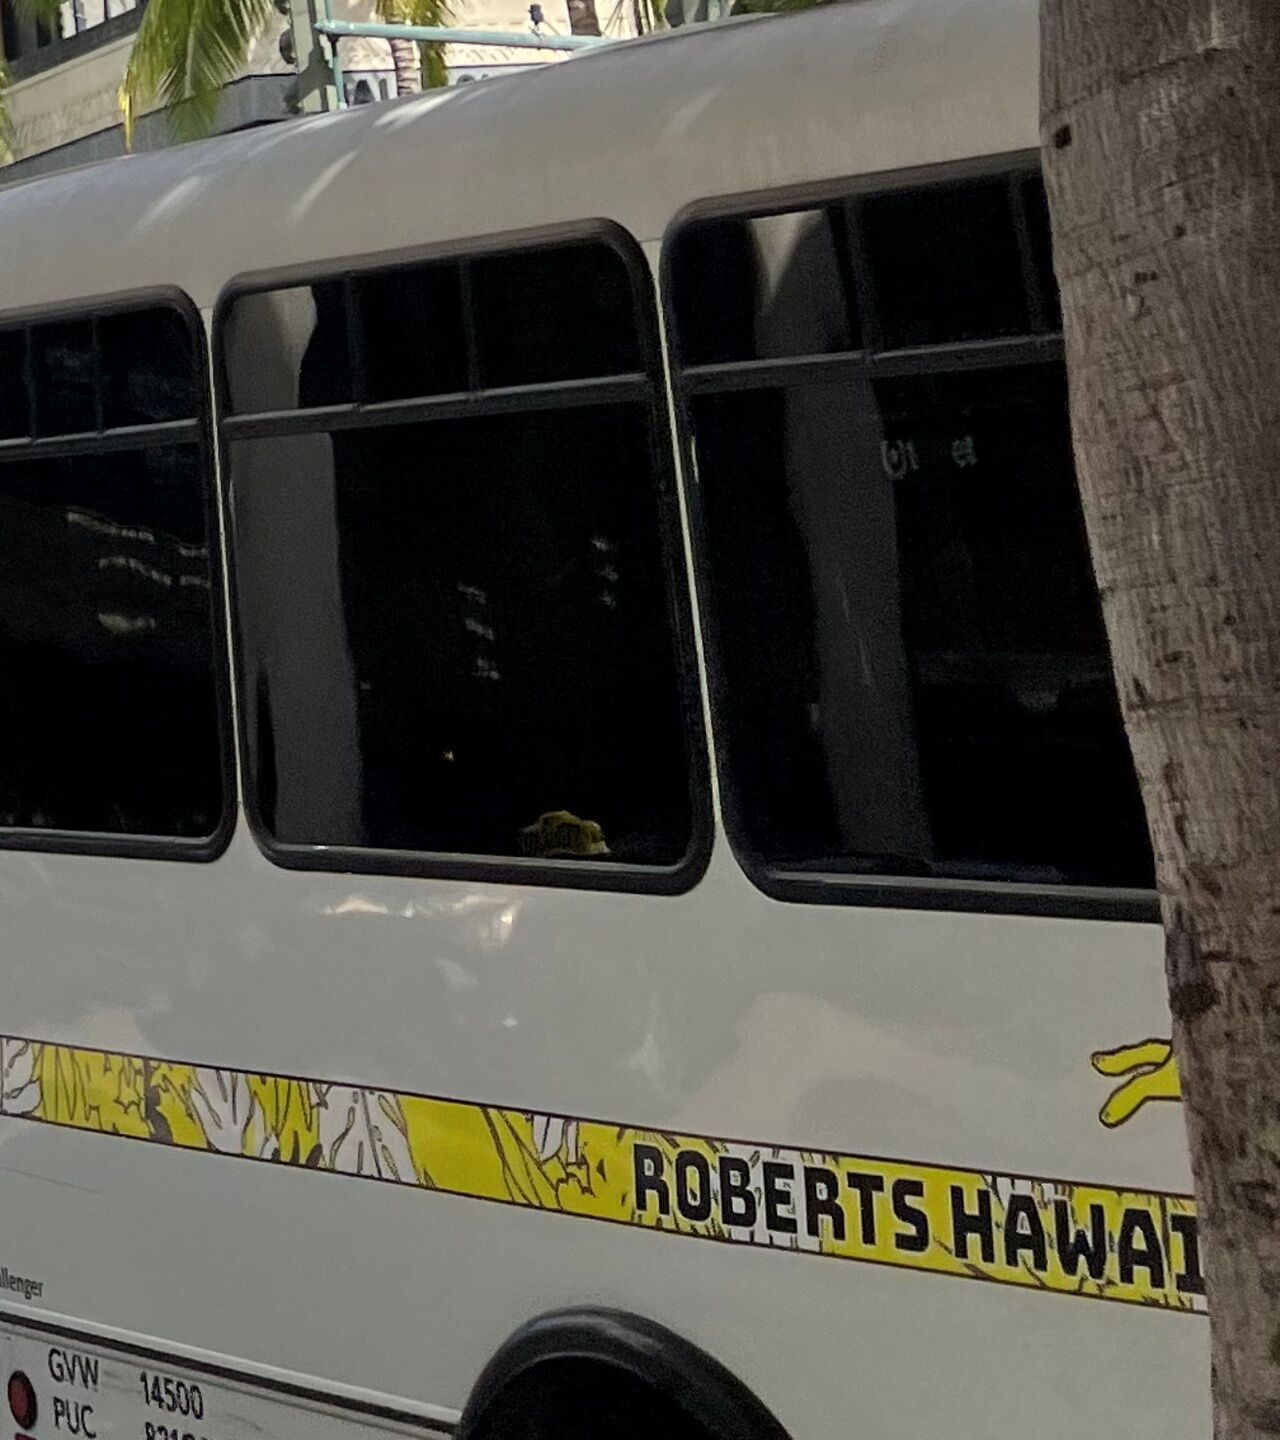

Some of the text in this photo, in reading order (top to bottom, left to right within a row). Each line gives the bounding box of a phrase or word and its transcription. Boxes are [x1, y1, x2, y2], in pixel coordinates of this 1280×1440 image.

[632, 1142, 1206, 1296] ROBERTS HAWAI
[47, 1347, 204, 1421] GVW 14500
[52, 1395, 98, 1439] PUC
